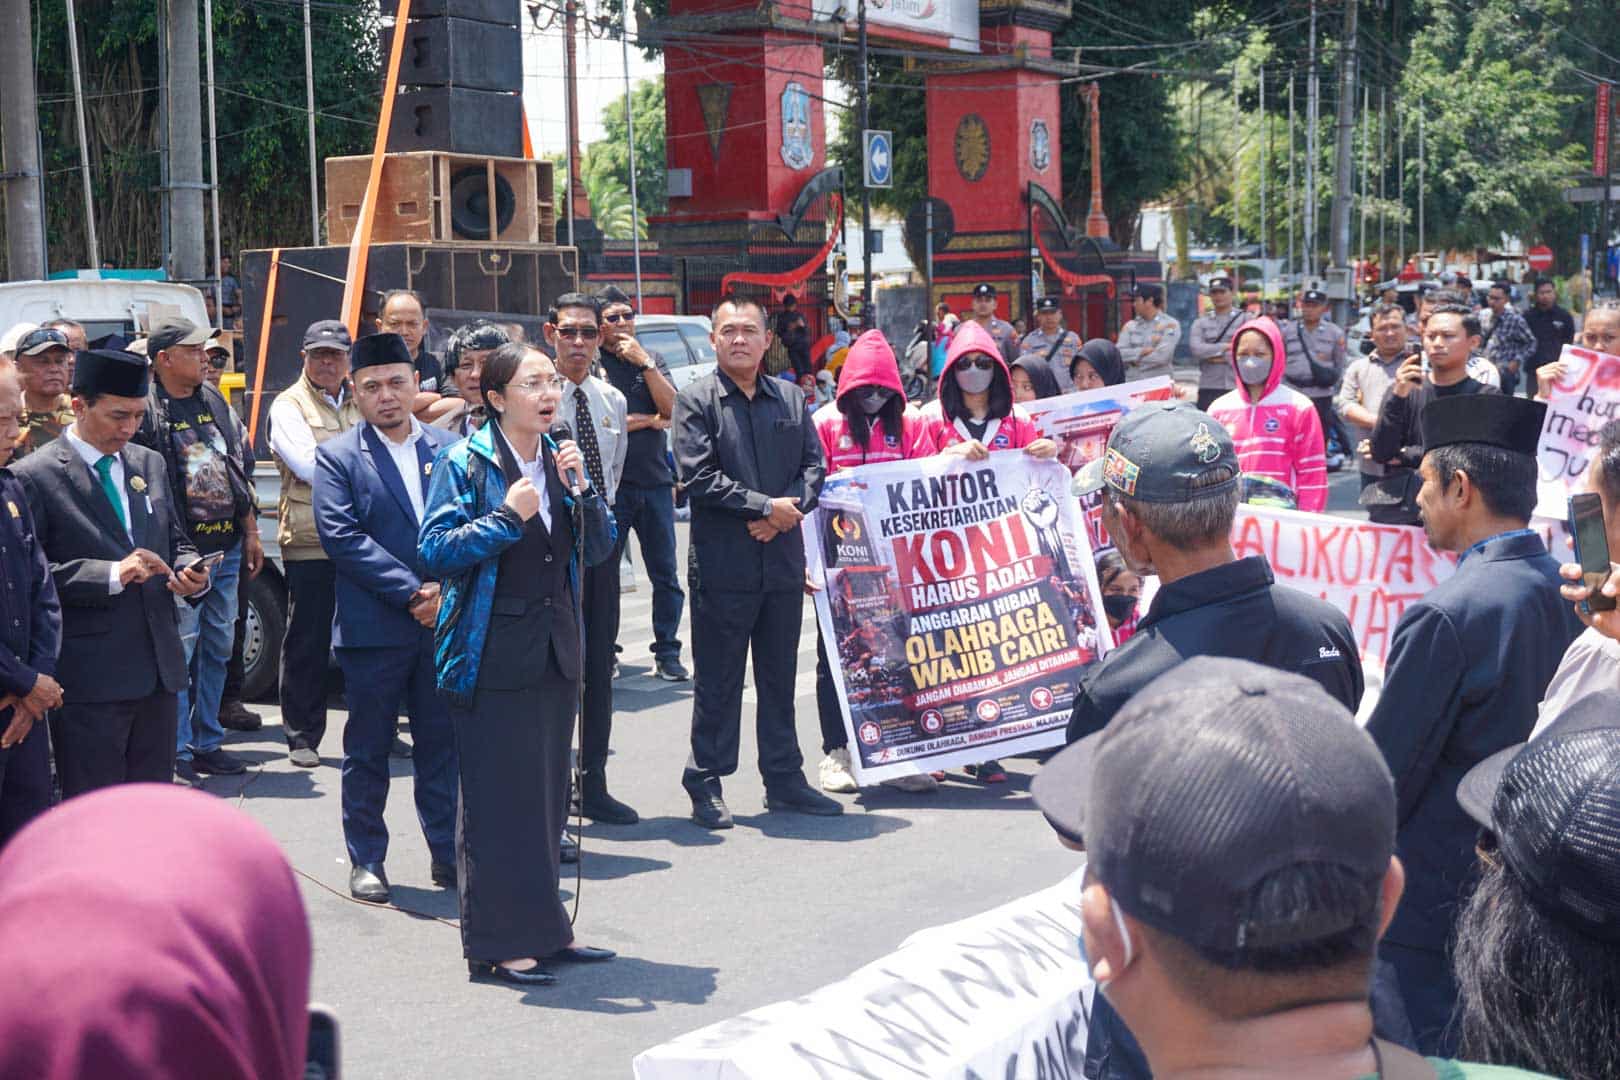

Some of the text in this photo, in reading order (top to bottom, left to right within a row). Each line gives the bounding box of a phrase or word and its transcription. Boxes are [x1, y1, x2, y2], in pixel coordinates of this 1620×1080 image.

[887, 468, 1000, 514] KANTOR
[880, 495, 1018, 537] KESEKRETARIATAN
[836, 544, 868, 557] KONI
[892, 513, 1032, 585] KONI
[1231, 516, 1414, 586] ALIKOTA
[911, 560, 1036, 609] HARUS ADA!
[905, 602, 1057, 664] OLAHRAGA
[910, 602, 992, 635] ANGGARAN
[994, 587, 1041, 616] HIBAH
[910, 624, 1069, 690] WAJIB CAIR!
[915, 684, 952, 707] JANGAN
